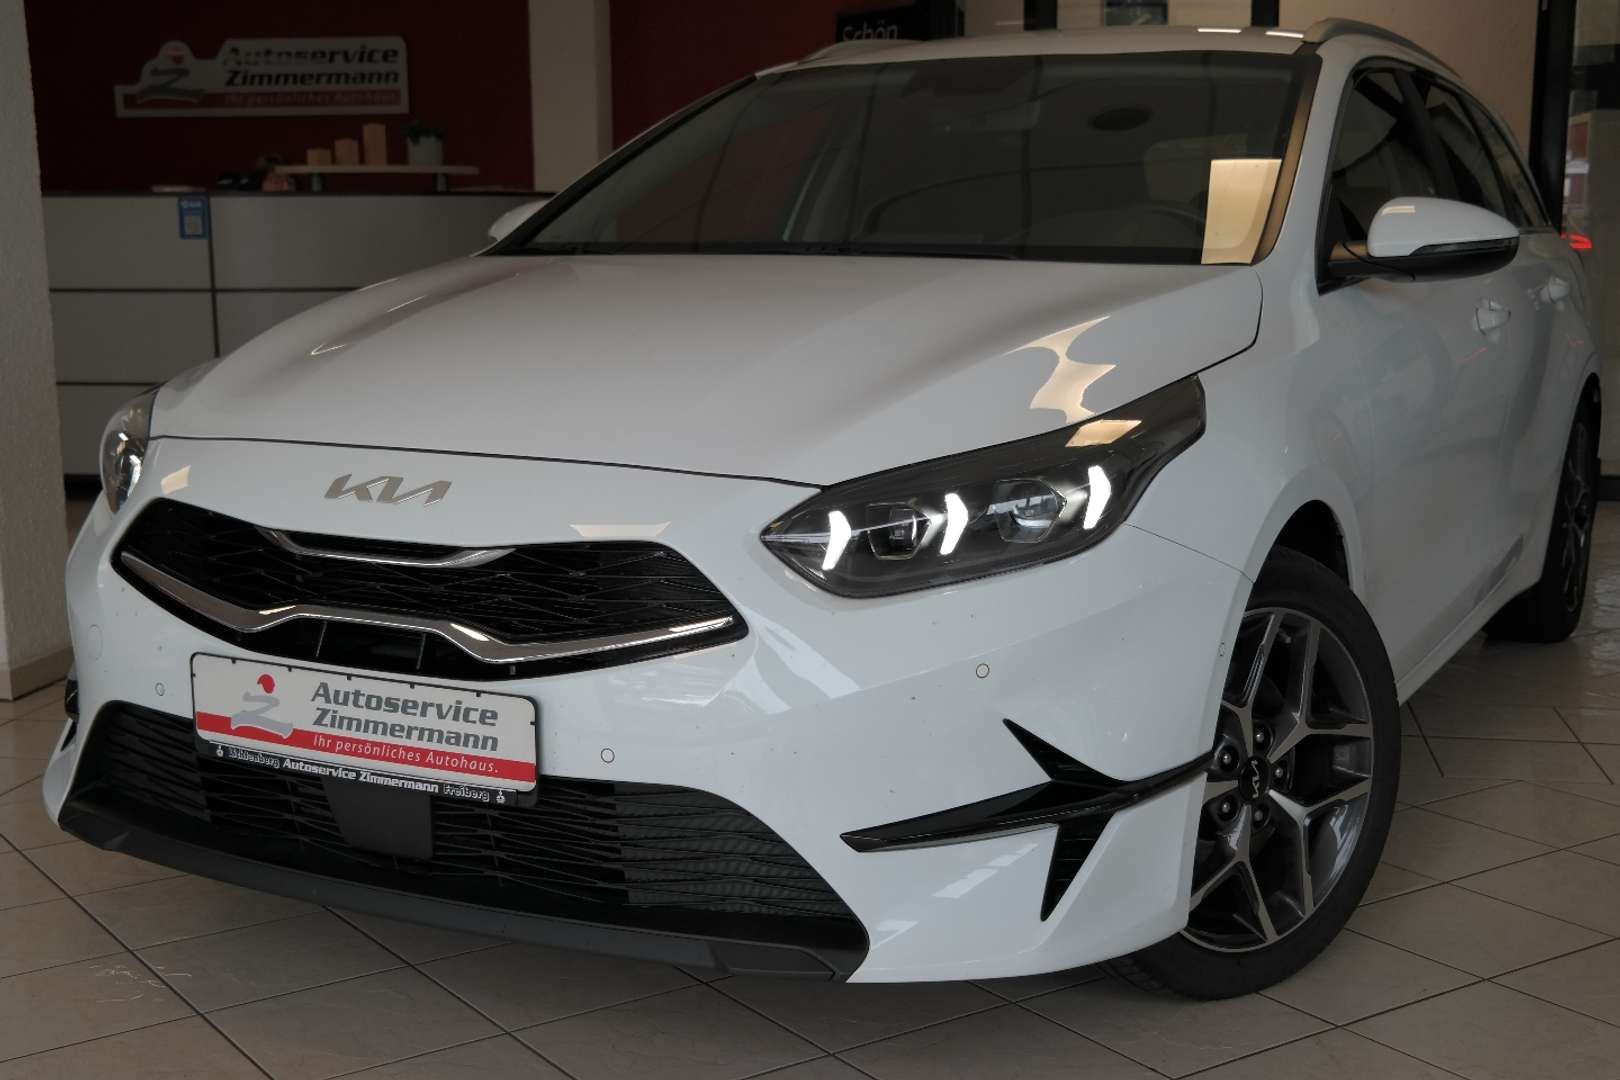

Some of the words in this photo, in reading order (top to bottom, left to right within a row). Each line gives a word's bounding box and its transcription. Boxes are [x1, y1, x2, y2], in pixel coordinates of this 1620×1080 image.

[842, 18, 898, 41] Schön
[224, 44, 399, 65] Autoservice
[225, 70, 399, 87] Zimmermann
[324, 473, 452, 505] KIA
[311, 682, 498, 726] Autoservice
[312, 707, 498, 751] Zimmermann
[313, 735, 332, 749] Ihr
[335, 740, 421, 762] persönliches
[425, 751, 499, 773] Autohaus.
[282, 758, 357, 780] Autoservice
[359, 770, 439, 793] Zimmermann
